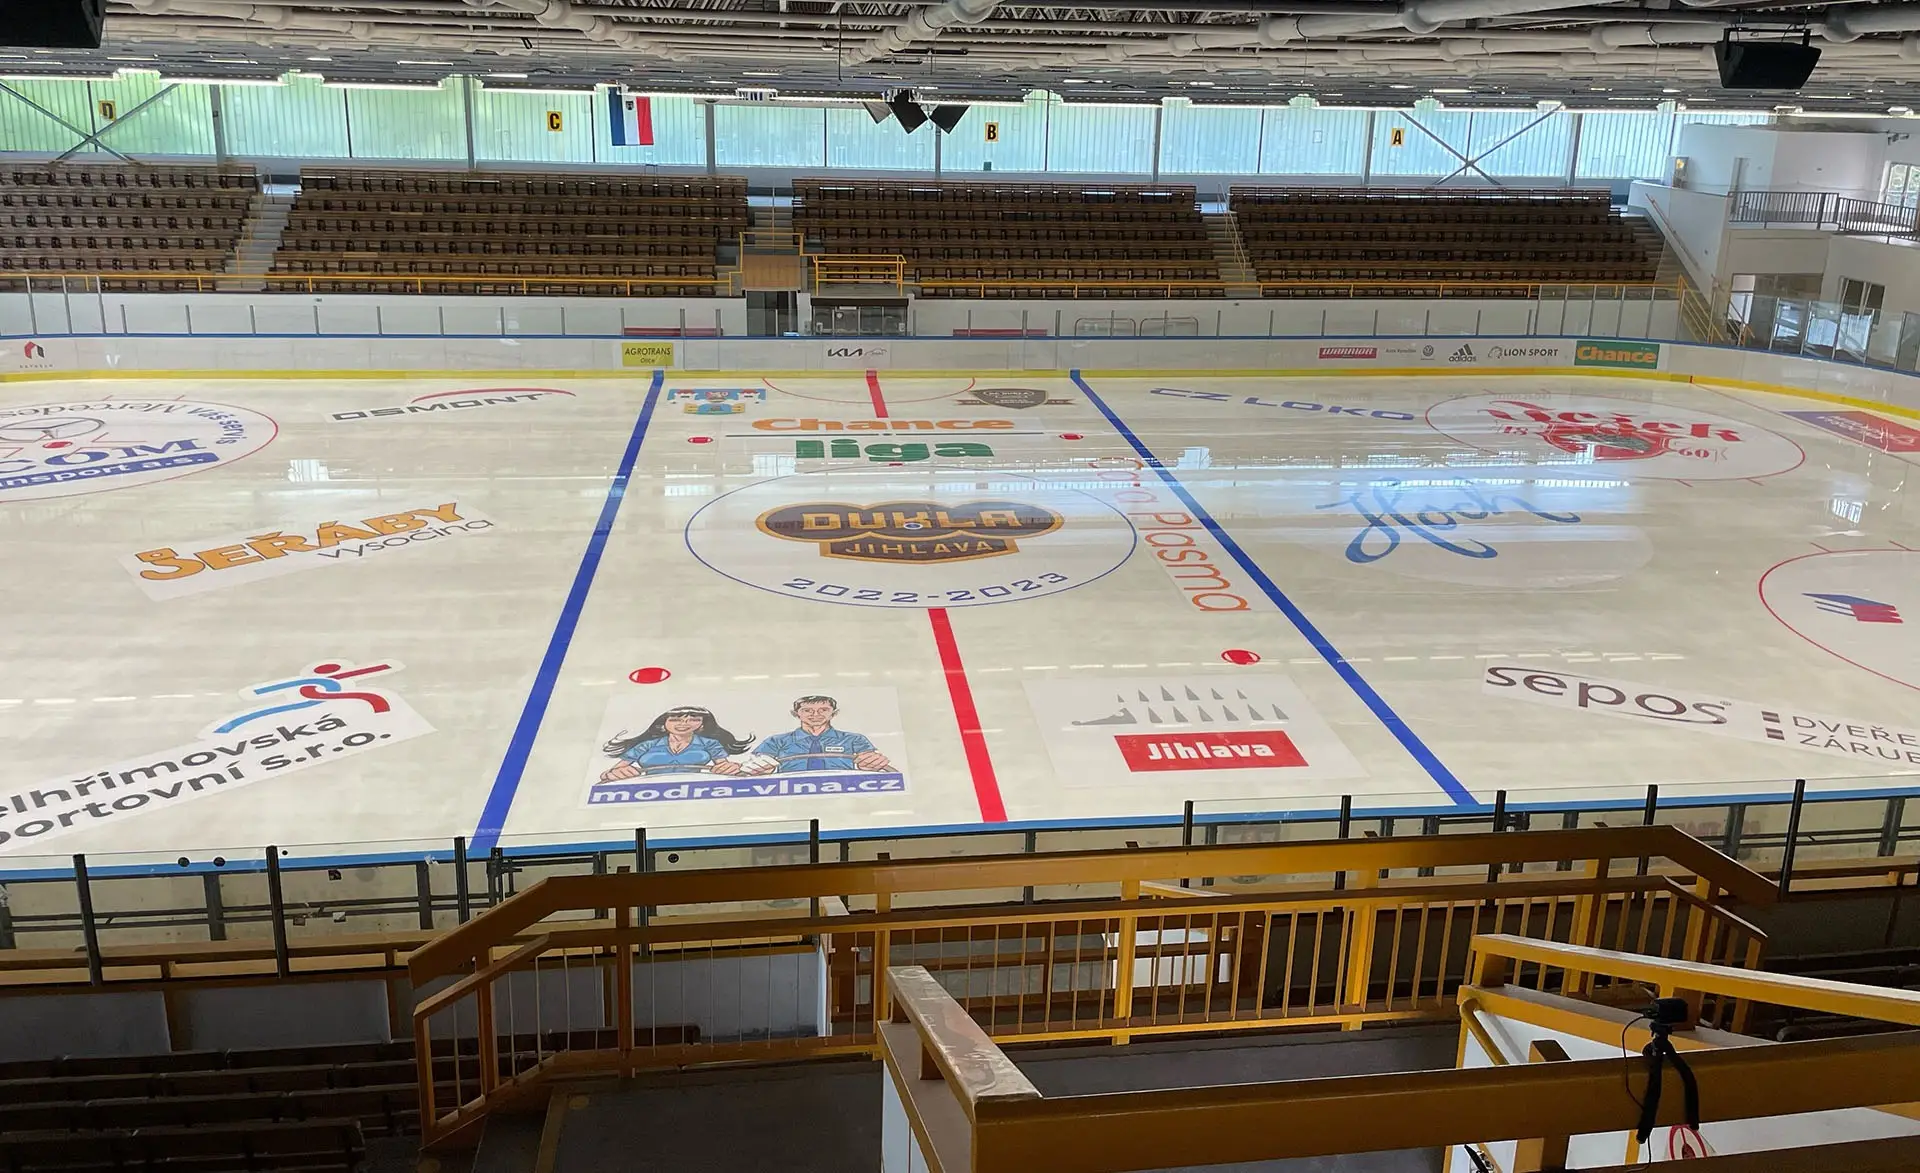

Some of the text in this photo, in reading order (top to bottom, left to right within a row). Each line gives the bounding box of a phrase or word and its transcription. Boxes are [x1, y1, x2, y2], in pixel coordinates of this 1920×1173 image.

[550, 113, 559, 129] C
[988, 125, 996, 139] B
[1393, 130, 1401, 144] A
[625, 347, 671, 356] AGROTRANS
[827, 348, 863, 357] KIA
[1504, 348, 1558, 357] LION SPORT
[1576, 346, 1657, 364] Chance
[332, 393, 543, 421] OSMONT
[1150, 387, 1414, 421] CZ LOKO
[751, 418, 1015, 431] Chance
[795, 438, 995, 462] liga
[0, 455, 205, 488] nsport a.s.
[803, 509, 1023, 531] DUKLA
[317, 519, 495, 559] vysočina
[846, 540, 994, 555] JIHLAVA
[782, 572, 1069, 603] 2022-2023
[1486, 666, 1729, 725] sepos
[1792, 715, 1920, 747] DVEŘE
[1147, 741, 1276, 760] Jihlava
[0, 712, 348, 818] lhřimovská
[0, 731, 392, 845] ortovní s.r.o.
[590, 777, 901, 804] modra-vlna.cz
